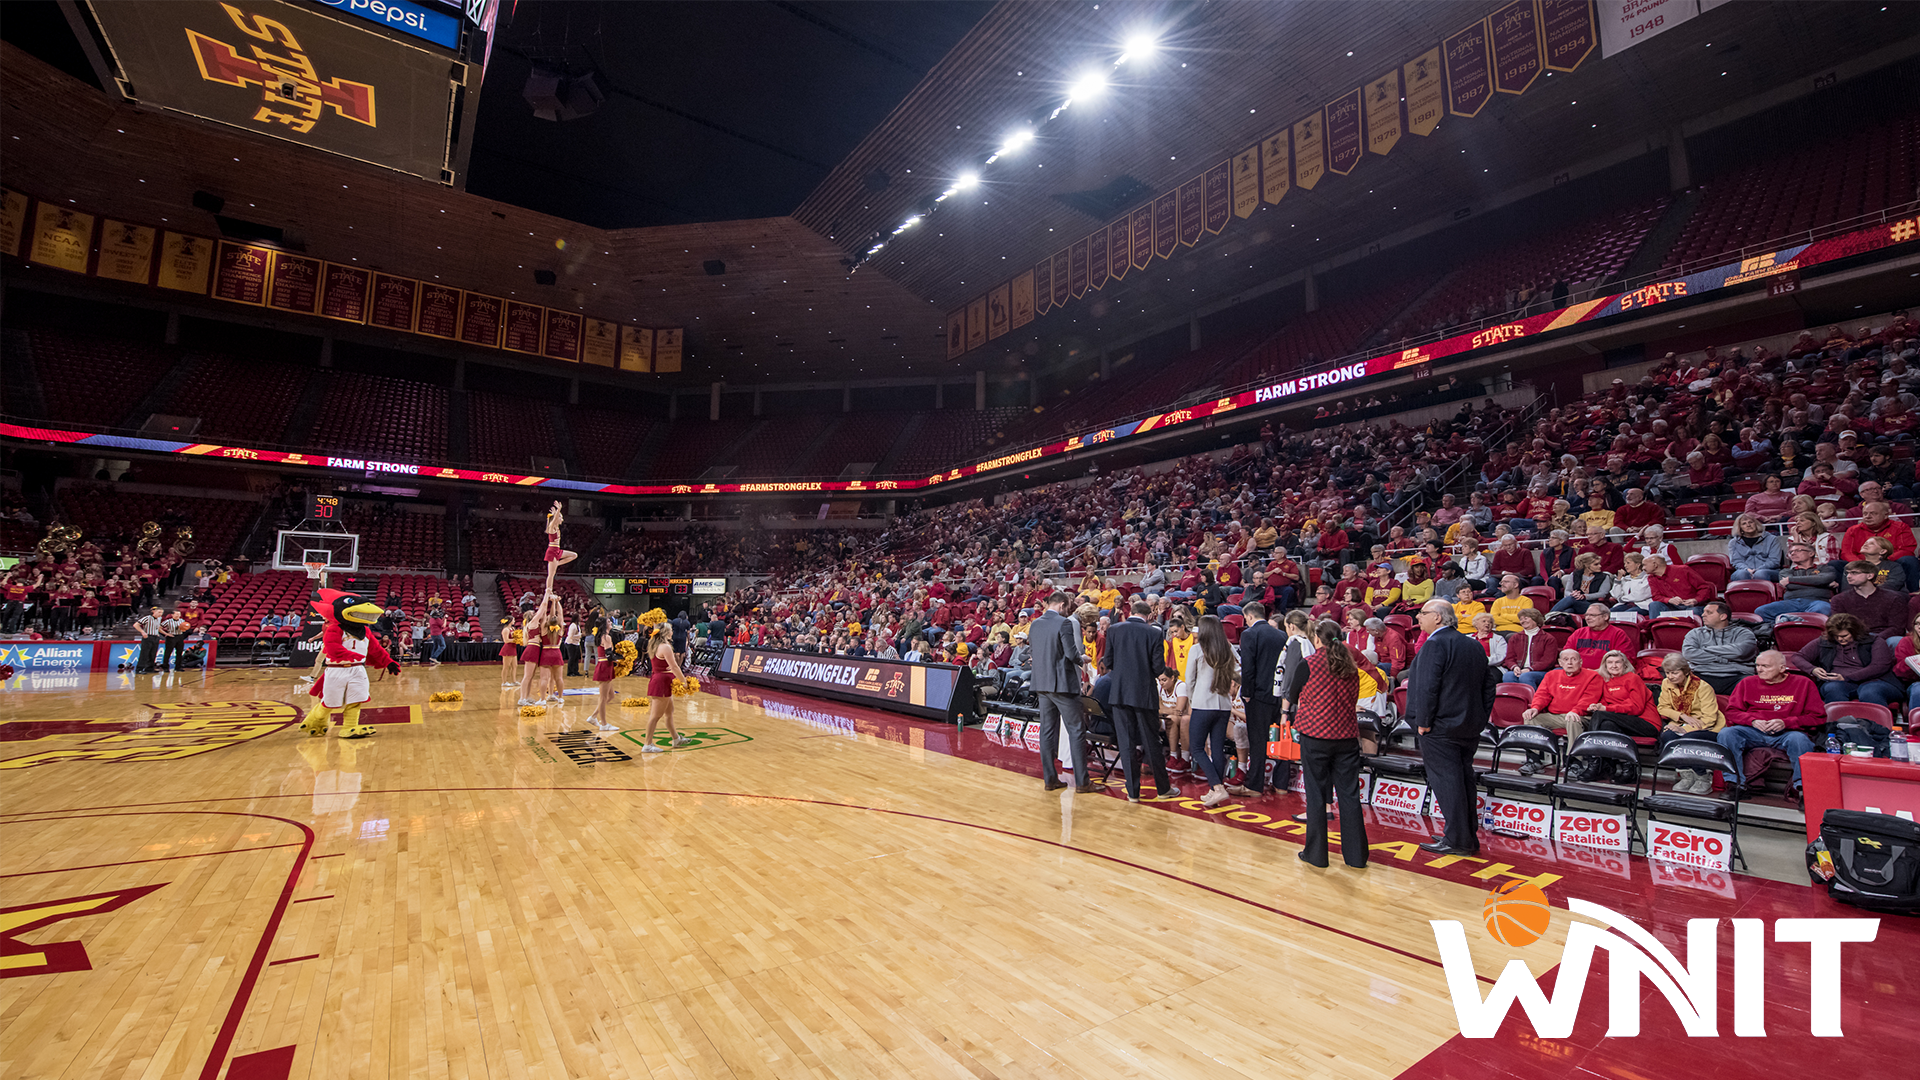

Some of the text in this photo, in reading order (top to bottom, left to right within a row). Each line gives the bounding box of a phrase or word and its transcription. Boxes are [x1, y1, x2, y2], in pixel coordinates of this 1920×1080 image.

[1621, 0, 1670, 23] 174 POUND
[1496, 10, 1531, 35] STATE
[1550, 17, 1586, 37] NATIONAL
[1629, 14, 1664, 38] 1948
[1548, 20, 1588, 43] CHAMPIONS
[1449, 36, 1482, 59] STATE
[1500, 42, 1534, 61] NATIONAL
[1554, 35, 1586, 57] 1994
[1499, 46, 1536, 68] CHAMPIONS
[1453, 67, 1485, 86] NATIONAL
[1504, 59, 1537, 81] 1989
[1453, 71, 1487, 91] CHAMPIONS
[1457, 84, 1485, 104] 1987
[1330, 103, 1357, 123] STATE
[1413, 109, 1436, 125] 1981
[1373, 128, 1397, 145] 1978
[1334, 147, 1357, 163] 1977
[1300, 164, 1321, 180] 1977
[1267, 180, 1286, 195] 1976
[1237, 196, 1256, 210] 1975
[1210, 210, 1226, 223] 1974
[43, 232, 81, 247] NCAA
[227, 251, 262, 266] STATE
[280, 262, 314, 276] STATE
[221, 272, 262, 283] CHAMPIONS
[331, 272, 363, 286] STATE
[380, 282, 410, 295] STATE
[1620, 281, 1687, 310] STATE
[1772, 282, 1796, 294] 113
[426, 292, 455, 304] STATE
[470, 300, 497, 312] STATE
[511, 309, 538, 321] STATE
[1472, 325, 1524, 349] STATE
[1255, 363, 1367, 403] FARM STRONG
[1164, 410, 1192, 426] STATE
[1092, 430, 1115, 444] STATE
[223, 448, 258, 460] STATE
[976, 447, 1042, 473] #FARMSTRONGFLEX
[327, 457, 420, 475] FARM STRONG
[482, 473, 509, 483] STATE
[875, 480, 898, 490] STATE
[671, 484, 692, 494] STATE
[740, 482, 822, 492] #FARMSTRONGFLEX
[317, 497, 339, 507] 4:48
[314, 504, 333, 518] 30
[33, 647, 83, 658] Alliant
[297, 641, 325, 653] HyV
[351, 640, 356, 650] 1
[32, 657, 80, 669] Energy
[763, 658, 861, 688] #FARMSTRONGFLEX
[884, 680, 905, 693] STATE
[1527, 733, 1549, 741] Cellular
[1603, 739, 1628, 748] Cellular
[1695, 749, 1724, 759] Cellular
[1376, 781, 1420, 801] zero
[1375, 795, 1416, 810] Fatalities
[1490, 801, 1545, 823] zero
[1493, 817, 1543, 834] atalities
[1560, 815, 1620, 835] zero
[1559, 832, 1621, 847] Fatalities
[1654, 827, 1723, 856] zero
[1653, 846, 1722, 870] Fatalities
